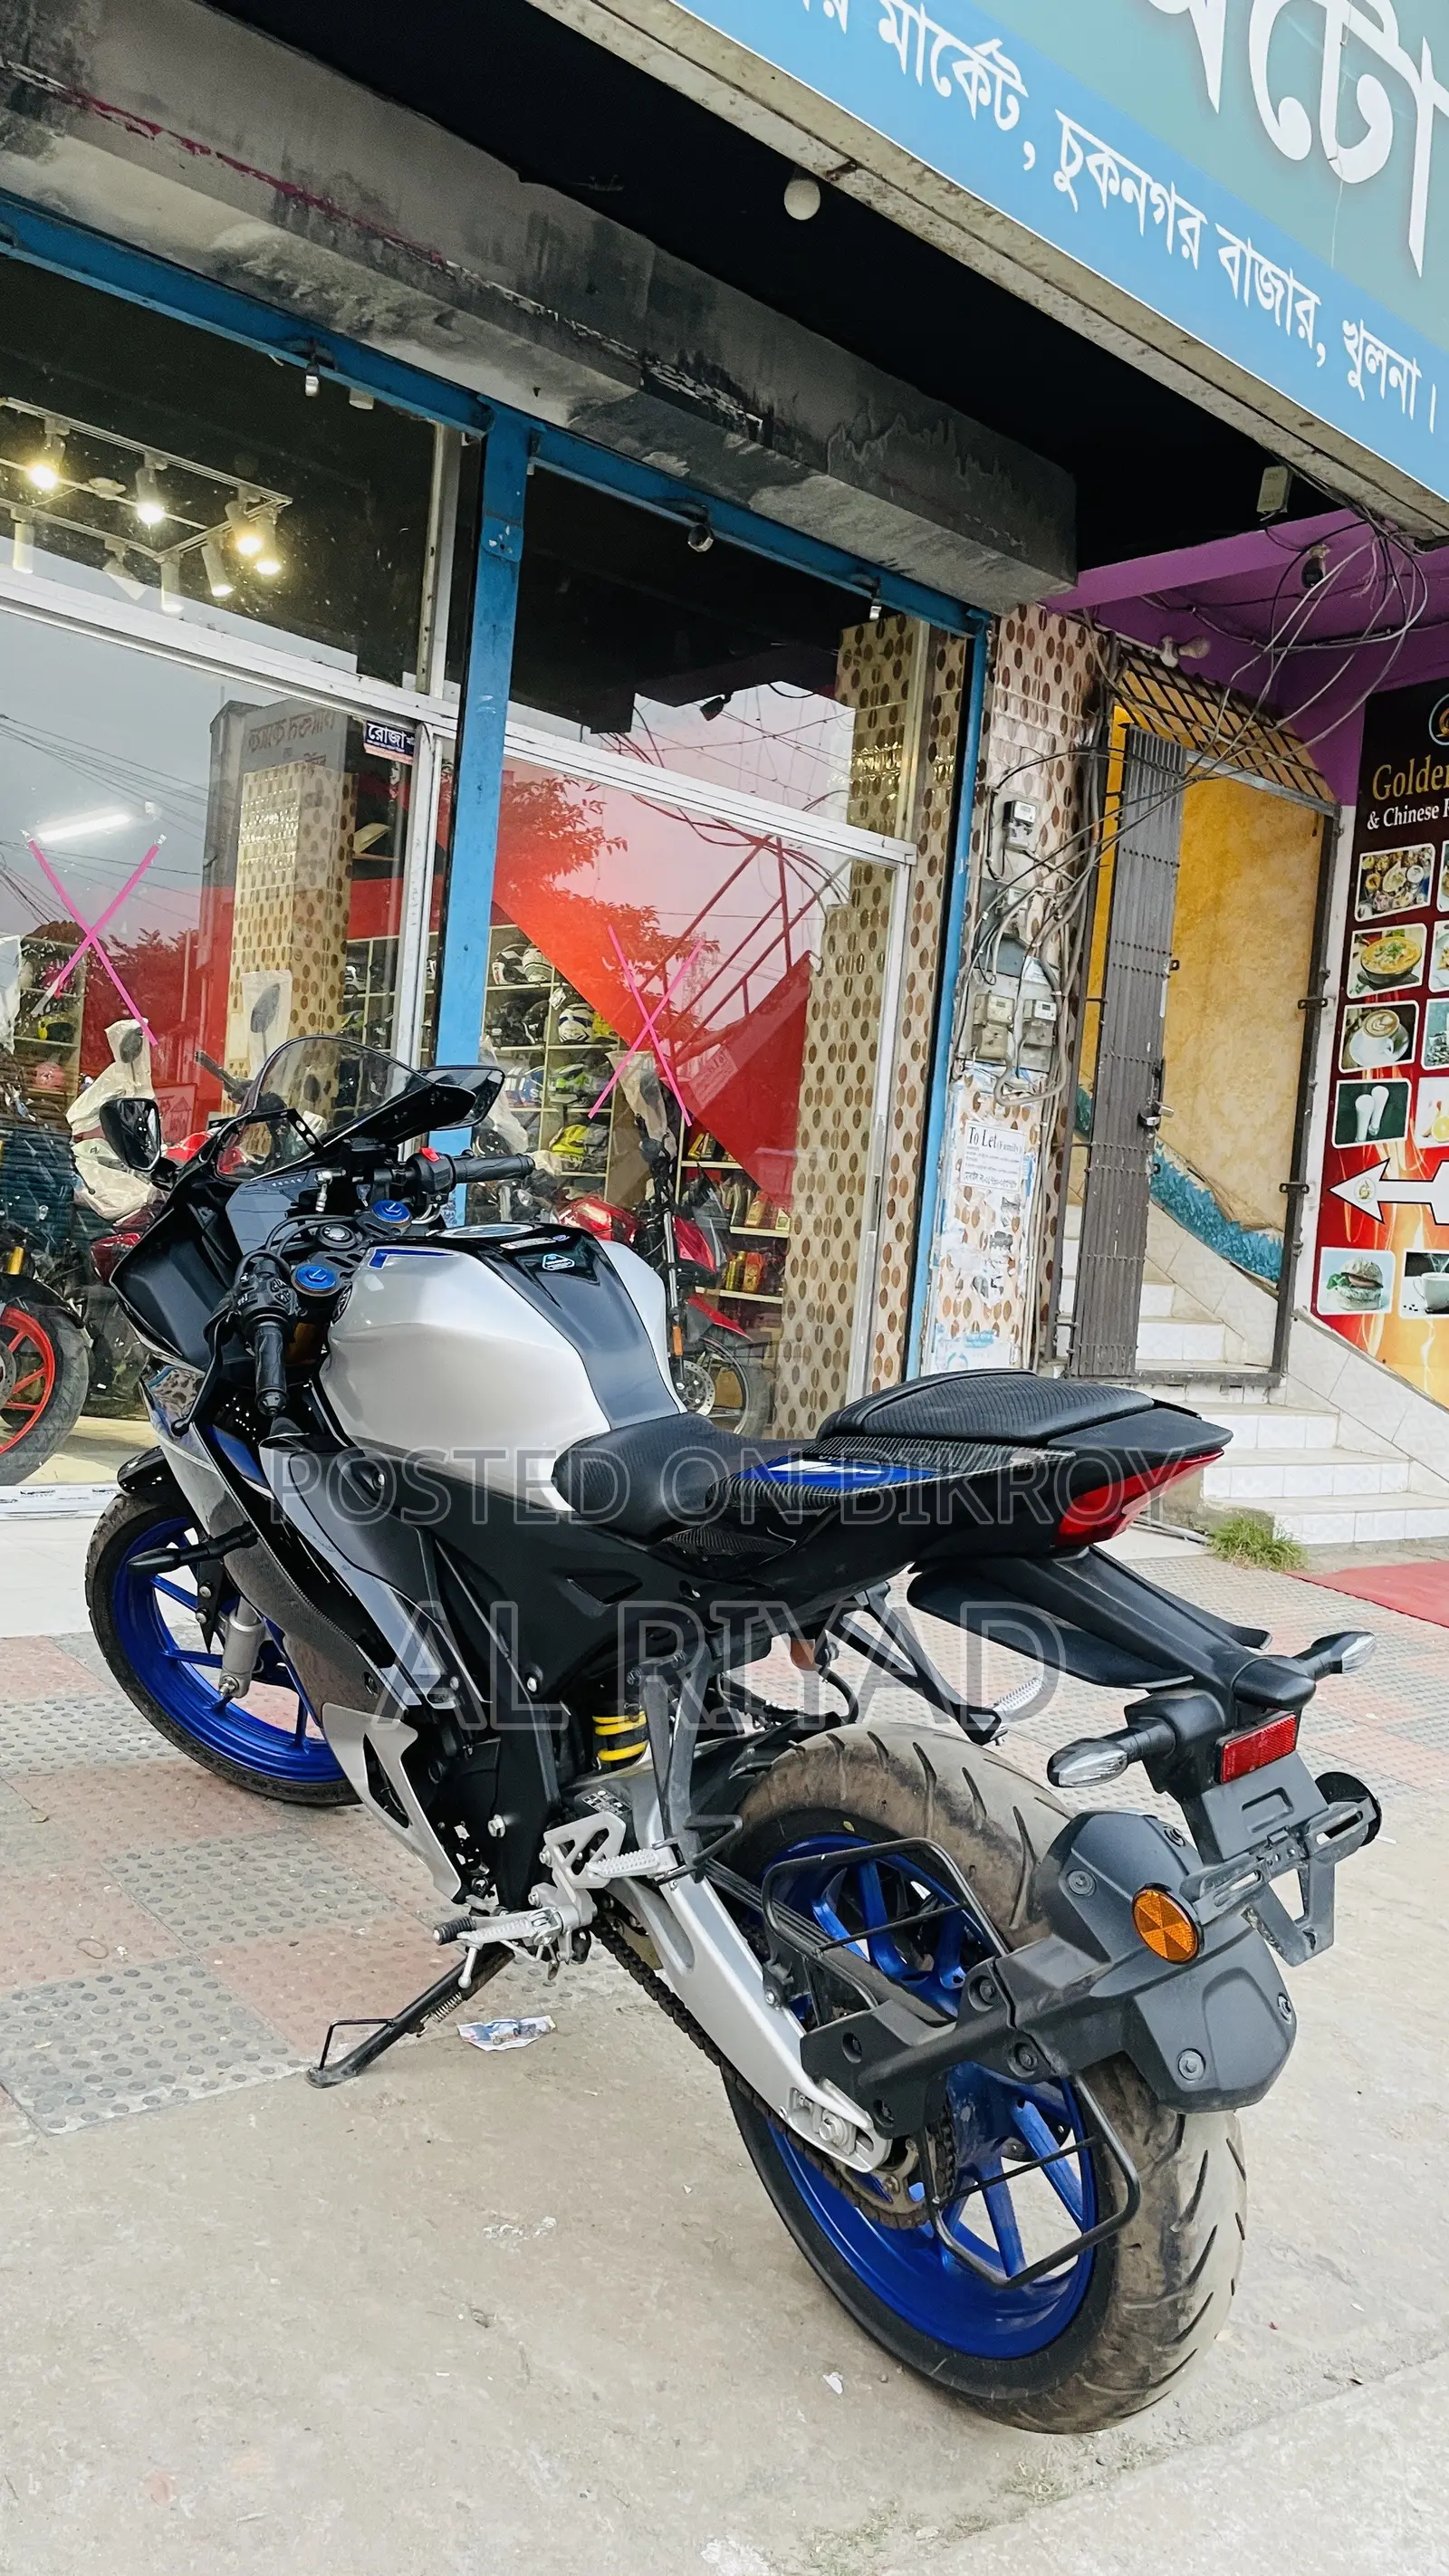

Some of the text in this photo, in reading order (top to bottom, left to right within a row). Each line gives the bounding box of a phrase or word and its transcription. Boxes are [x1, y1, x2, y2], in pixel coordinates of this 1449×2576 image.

[1053, 109, 1209, 271] চুকনগর
[1214, 223, 1326, 368] বাজার,
[367, 723, 408, 749] রোজা
[1367, 810, 1380, 830] &
[1383, 804, 1440, 828] Chinese
[969, 1126, 979, 1144] To
[982, 1129, 997, 1149] Let
